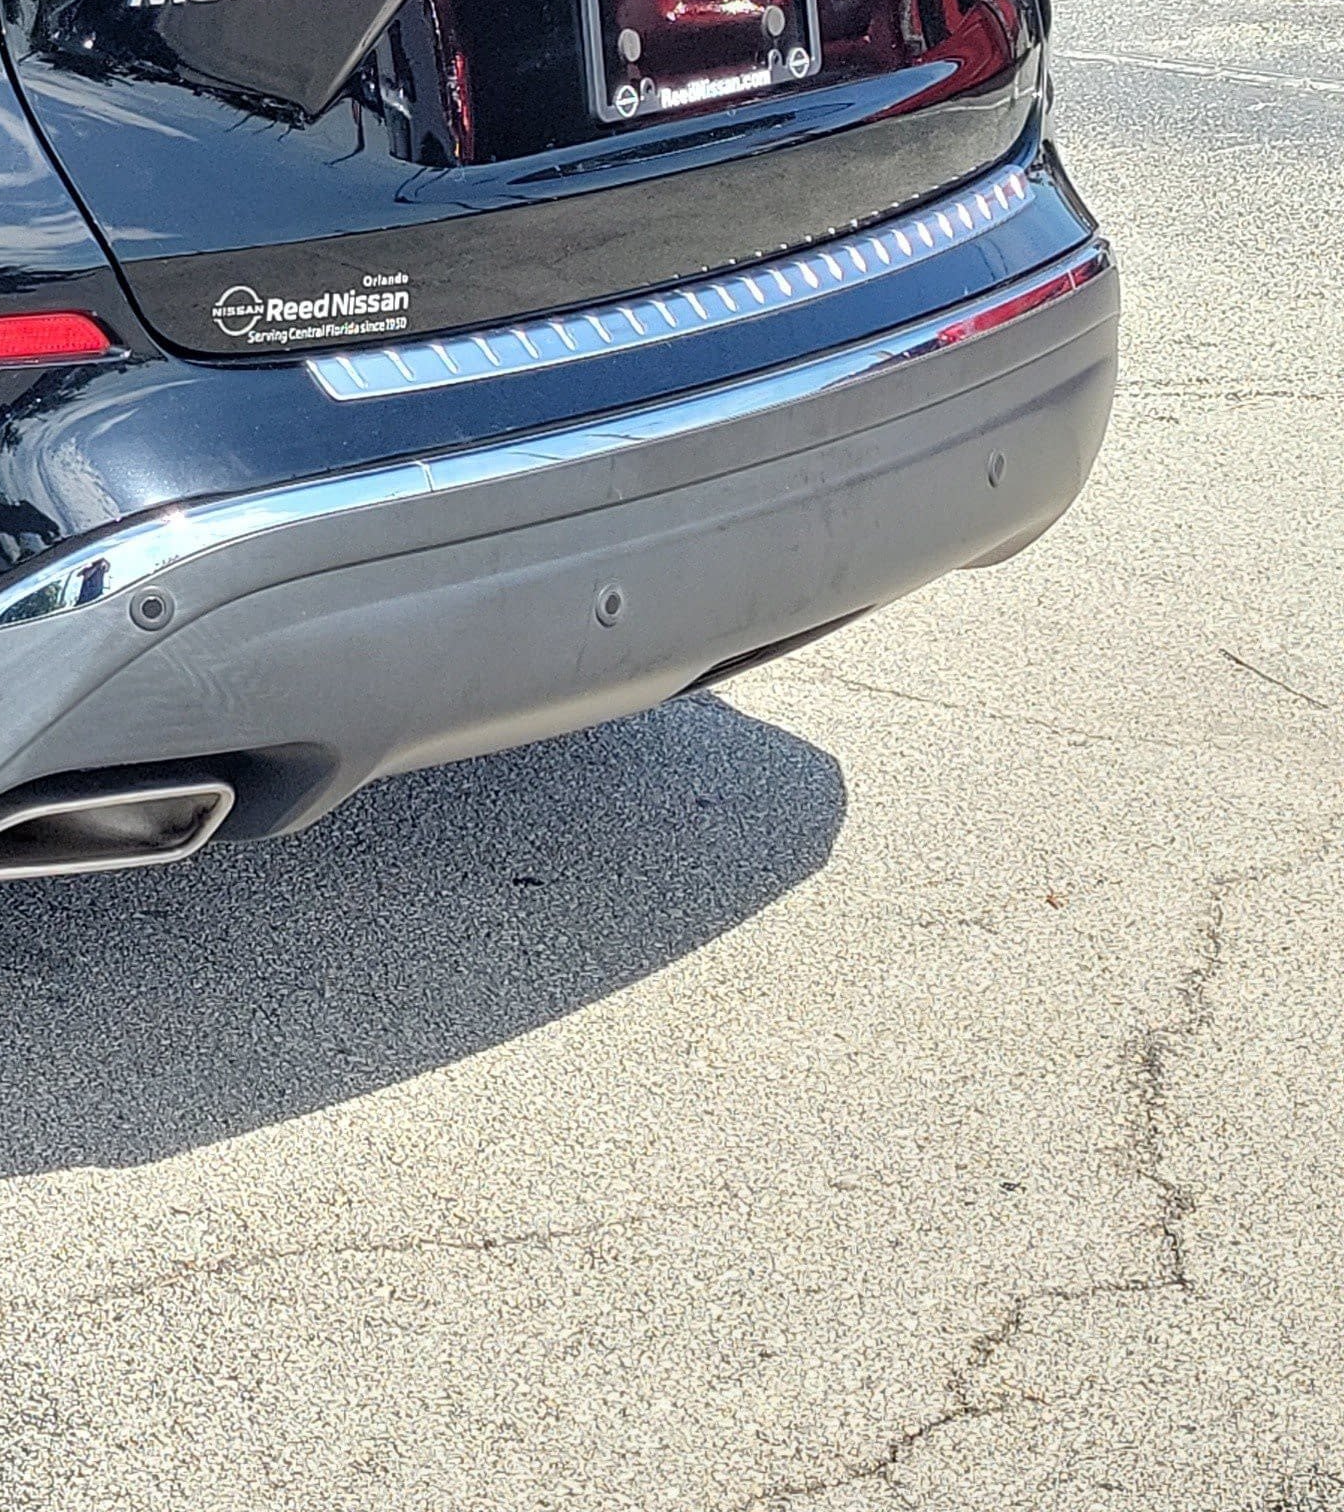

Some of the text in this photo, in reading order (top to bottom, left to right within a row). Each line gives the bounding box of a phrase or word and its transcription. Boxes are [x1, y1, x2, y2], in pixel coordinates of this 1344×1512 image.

[363, 272, 409, 288] Orlando
[212, 289, 409, 322] NISSAN Reed Nissan
[247, 329, 288, 344] Serving
[289, 324, 325, 340] Central
[325, 322, 359, 337] Florida
[359, 319, 385, 334] since
